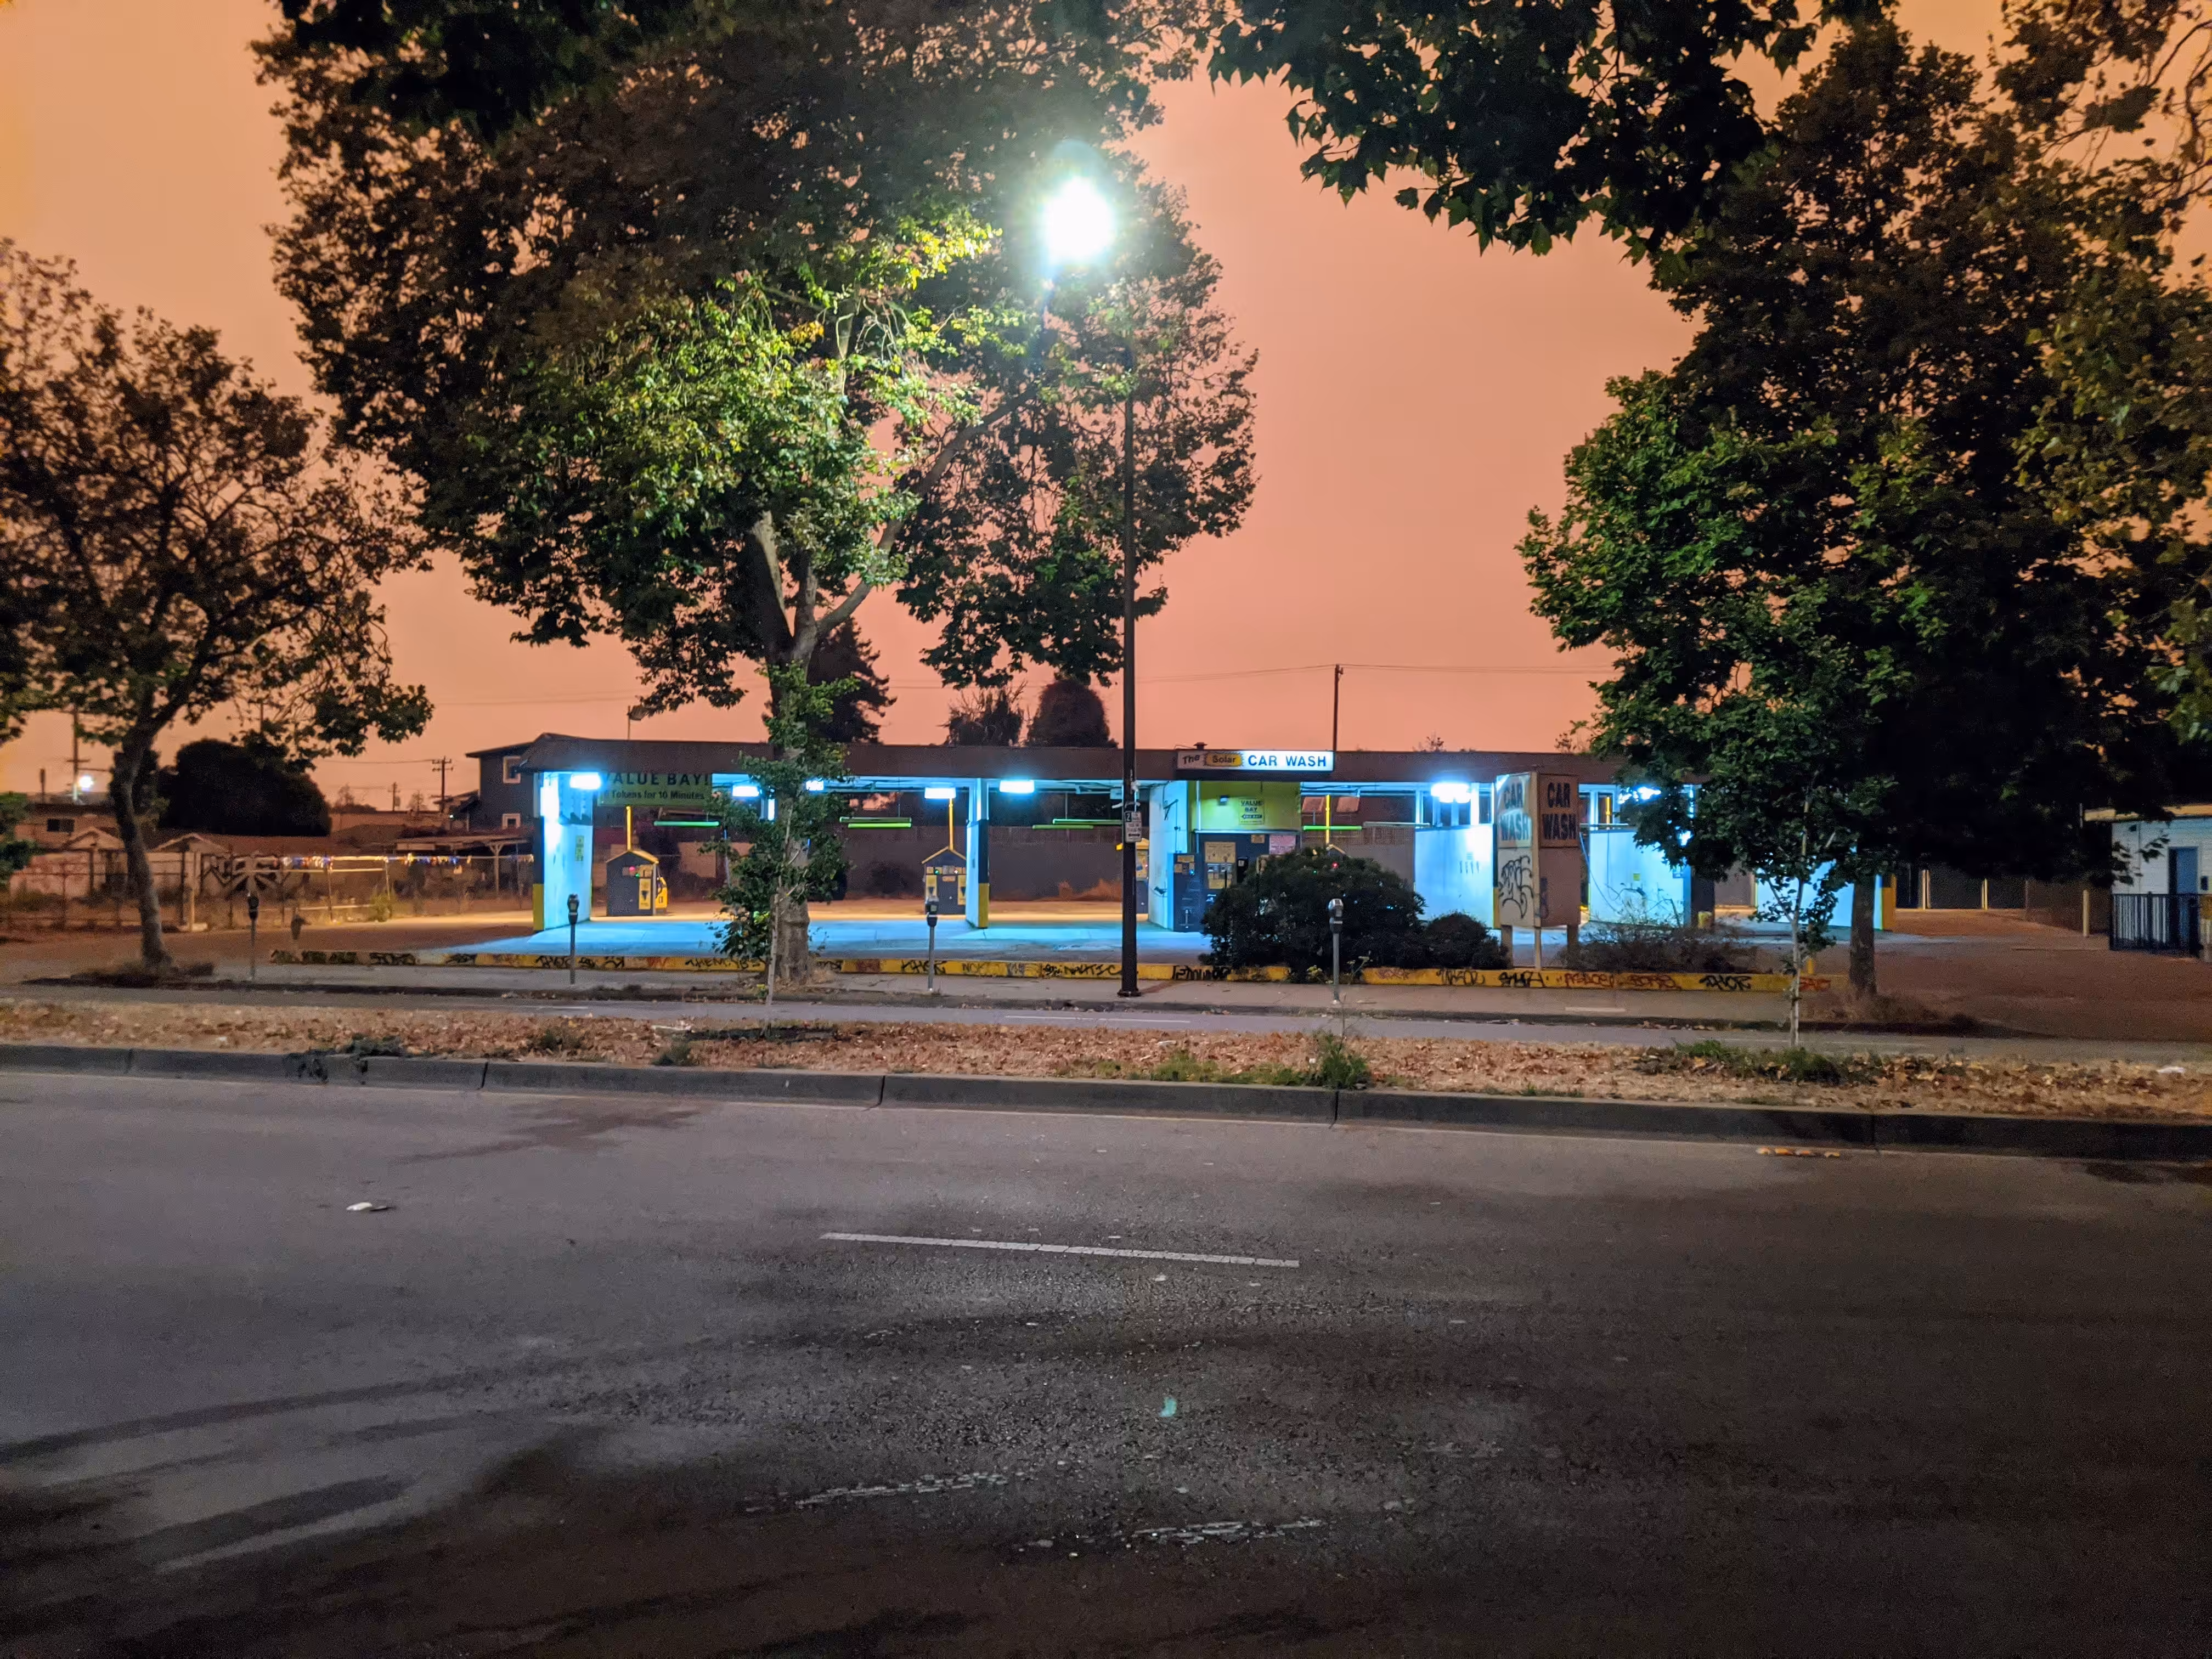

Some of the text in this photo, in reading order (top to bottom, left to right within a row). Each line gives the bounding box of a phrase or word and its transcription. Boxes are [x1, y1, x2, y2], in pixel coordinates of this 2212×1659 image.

[1182, 754, 1327, 767] The Solar CAR WASH
[612, 790, 641, 799] Tokens
[644, 790, 656, 799] for
[659, 791, 668, 799] 10
[670, 791, 704, 799] Minutes
[1504, 782, 1524, 809] CAR
[1547, 782, 1571, 808] CAR
[1500, 813, 1530, 840] WASH
[1542, 814, 1577, 840] WASH
